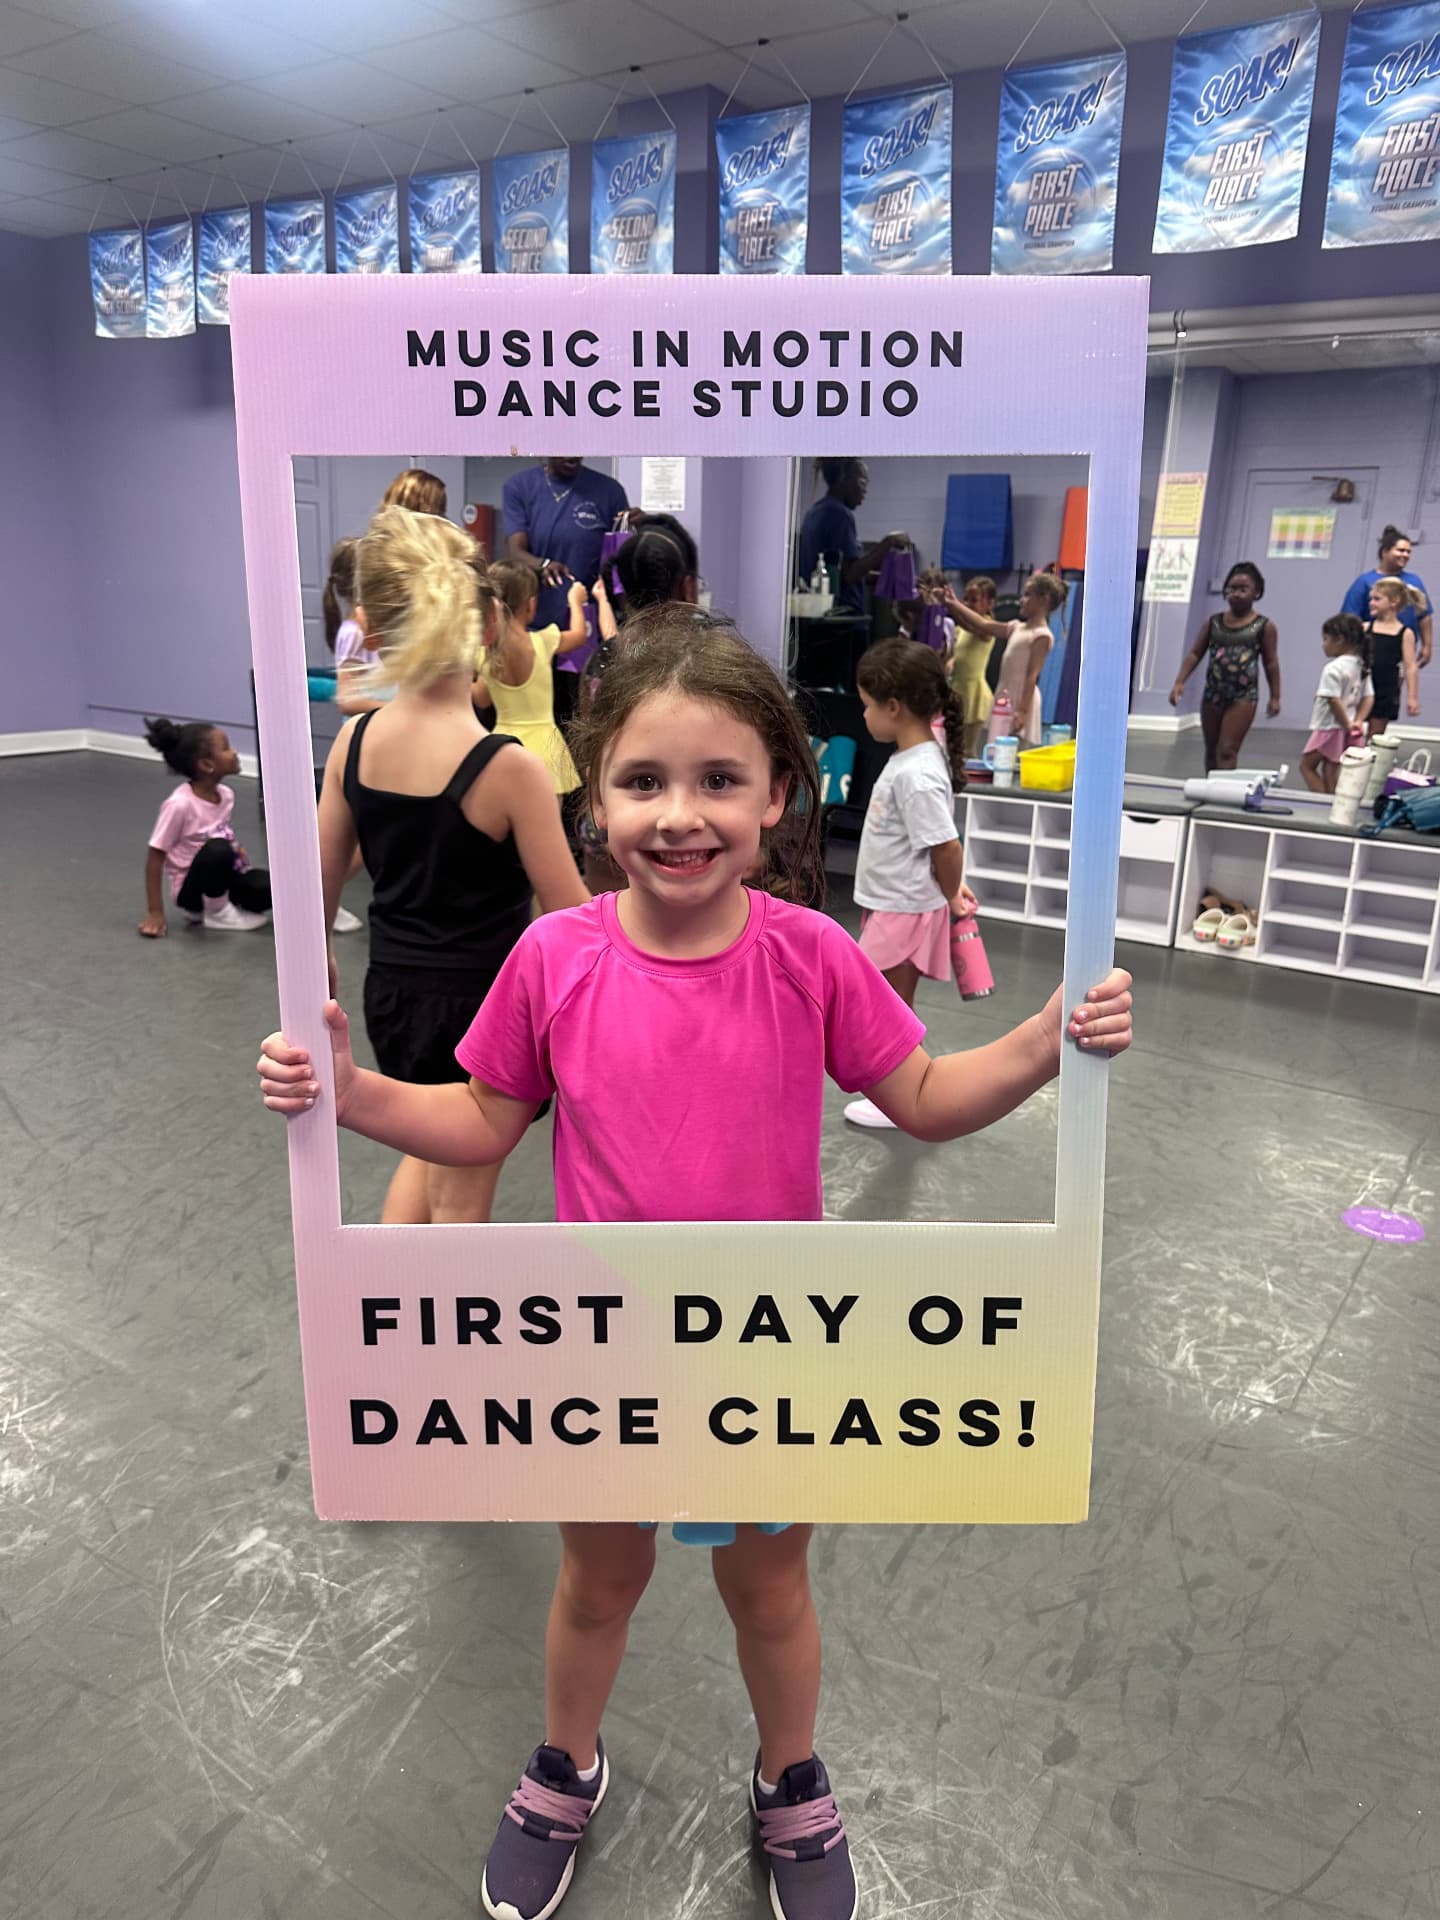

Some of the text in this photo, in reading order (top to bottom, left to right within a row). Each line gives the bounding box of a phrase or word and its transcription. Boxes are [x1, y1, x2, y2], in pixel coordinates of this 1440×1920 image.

[1195, 38, 1299, 126] SOAR!
[1014, 76, 1108, 153] SOAR!
[722, 127, 794, 192] SOAR!
[860, 101, 938, 179] SOAR!
[1212, 130, 1272, 174] FIRST
[607, 143, 667, 203] SOAR!
[1030, 163, 1084, 200] FIRST
[1205, 171, 1262, 211] PLACE
[1371, 155, 1439, 199] PLACE
[736, 202, 778, 235] FIRST
[875, 181, 920, 219] FIRST
[1024, 202, 1075, 238] PLACE
[736, 235, 776, 267] PLACE
[870, 216, 915, 251] PLACE
[614, 240, 650, 268] PLACE
[406, 329, 963, 368] MUSIC IN MOTION
[453, 380, 919, 418] DANCE STUDIO
[361, 1294, 1023, 1346] FIRST DAY OF
[349, 1397, 1036, 1448] DANCE CLASS!
